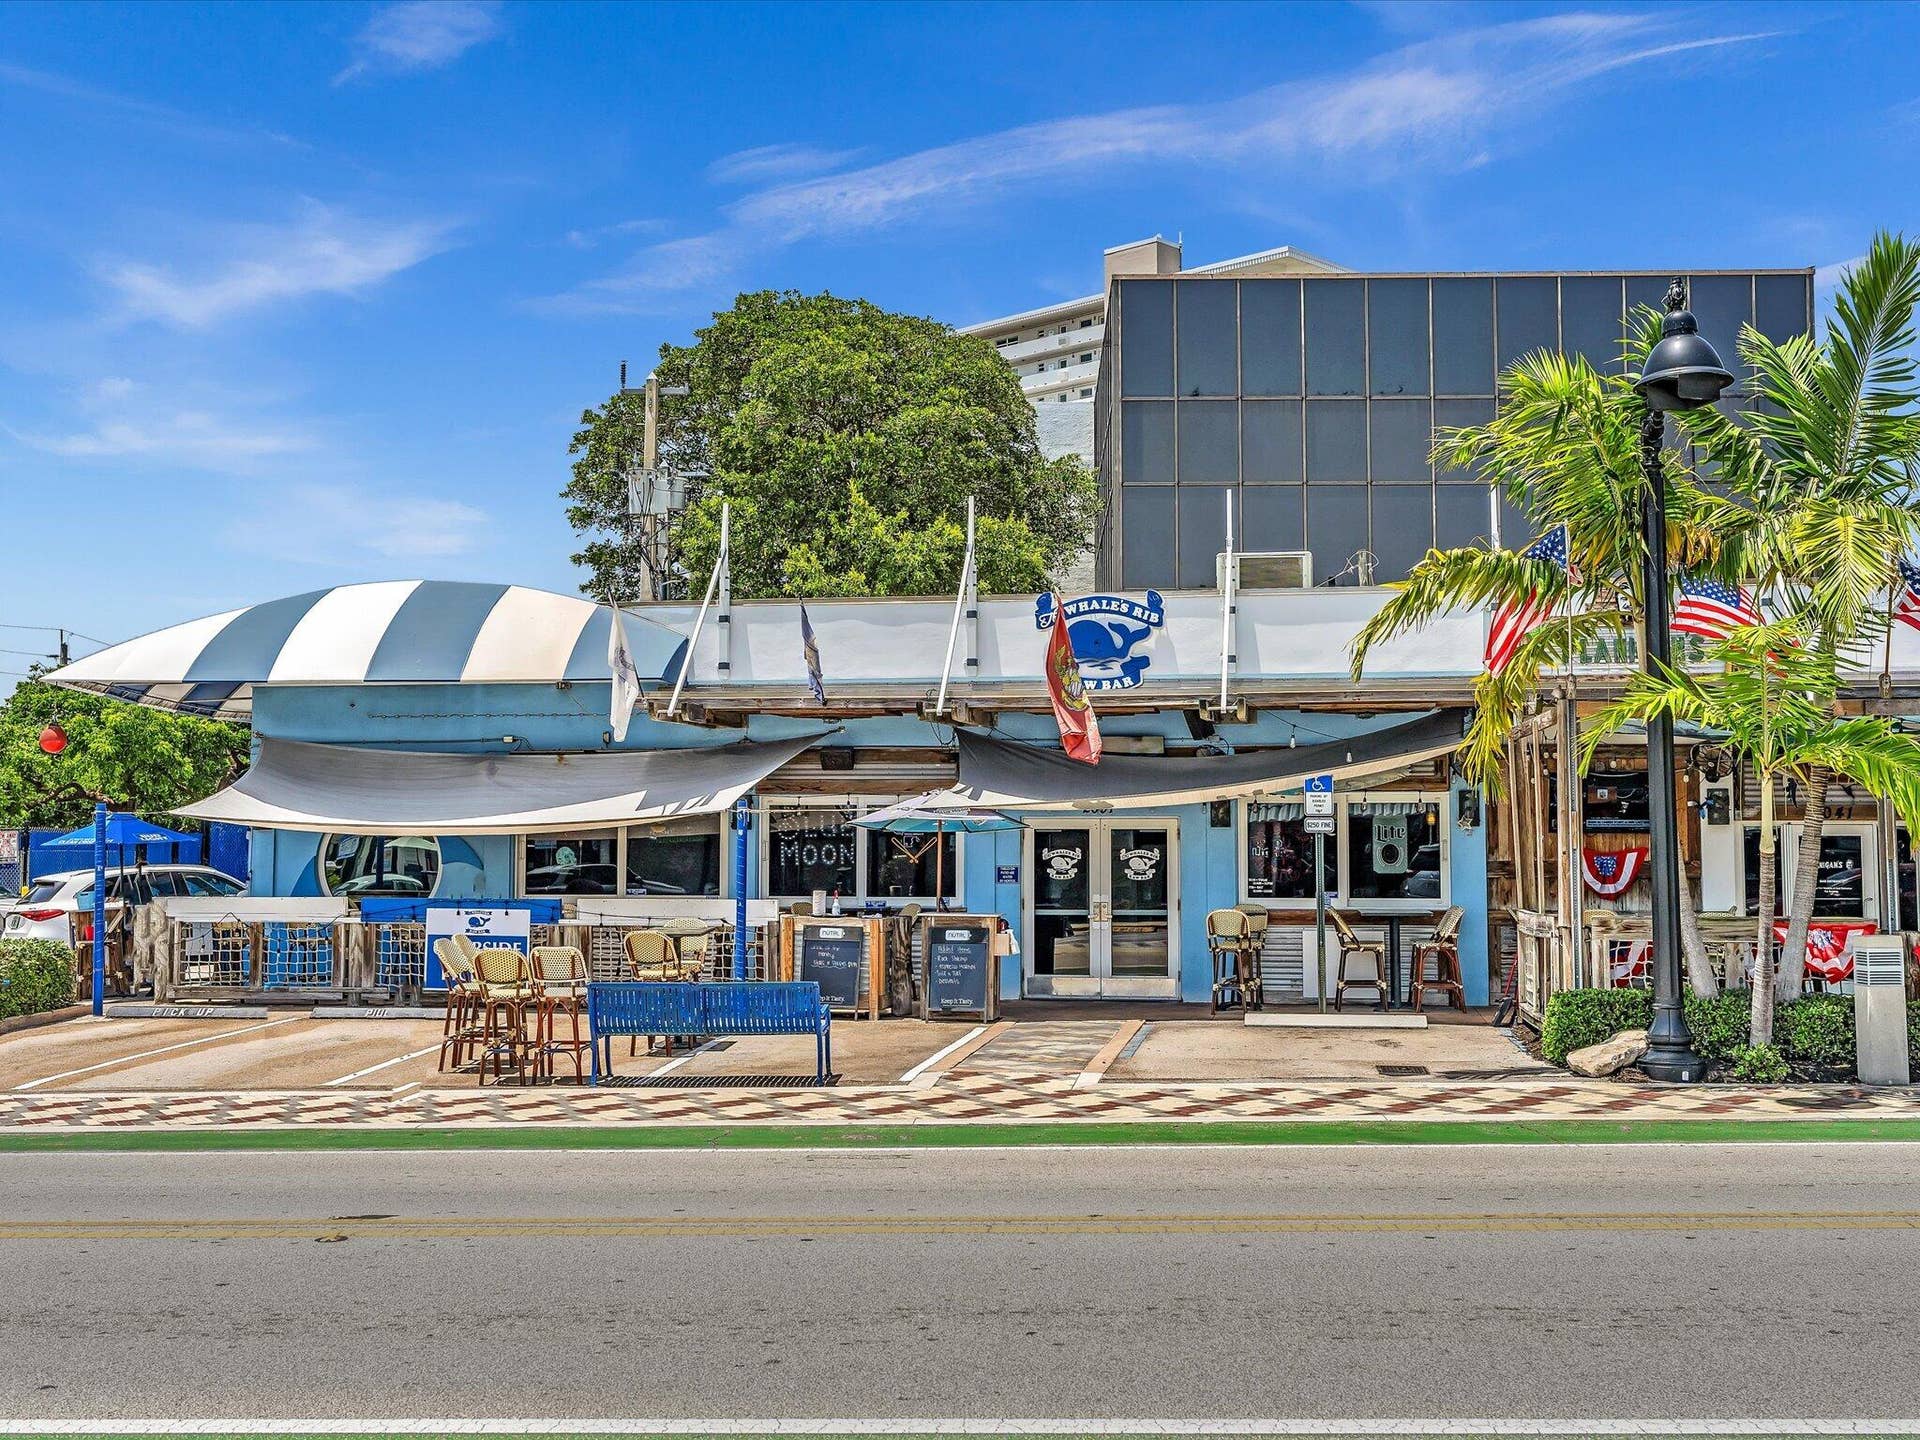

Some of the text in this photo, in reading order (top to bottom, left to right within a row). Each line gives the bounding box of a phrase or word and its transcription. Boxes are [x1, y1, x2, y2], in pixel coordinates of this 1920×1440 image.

[1064, 599, 1130, 616] WHALE'S
[1132, 607, 1160, 623] RIB
[1101, 677, 1134, 690] BAR
[1824, 806, 1853, 819] 041
[1307, 821, 1332, 829] $250 FINE
[1374, 824, 1407, 843] Lite
[780, 841, 855, 866] MOON
[152, 1007, 215, 1017] PICK UP
